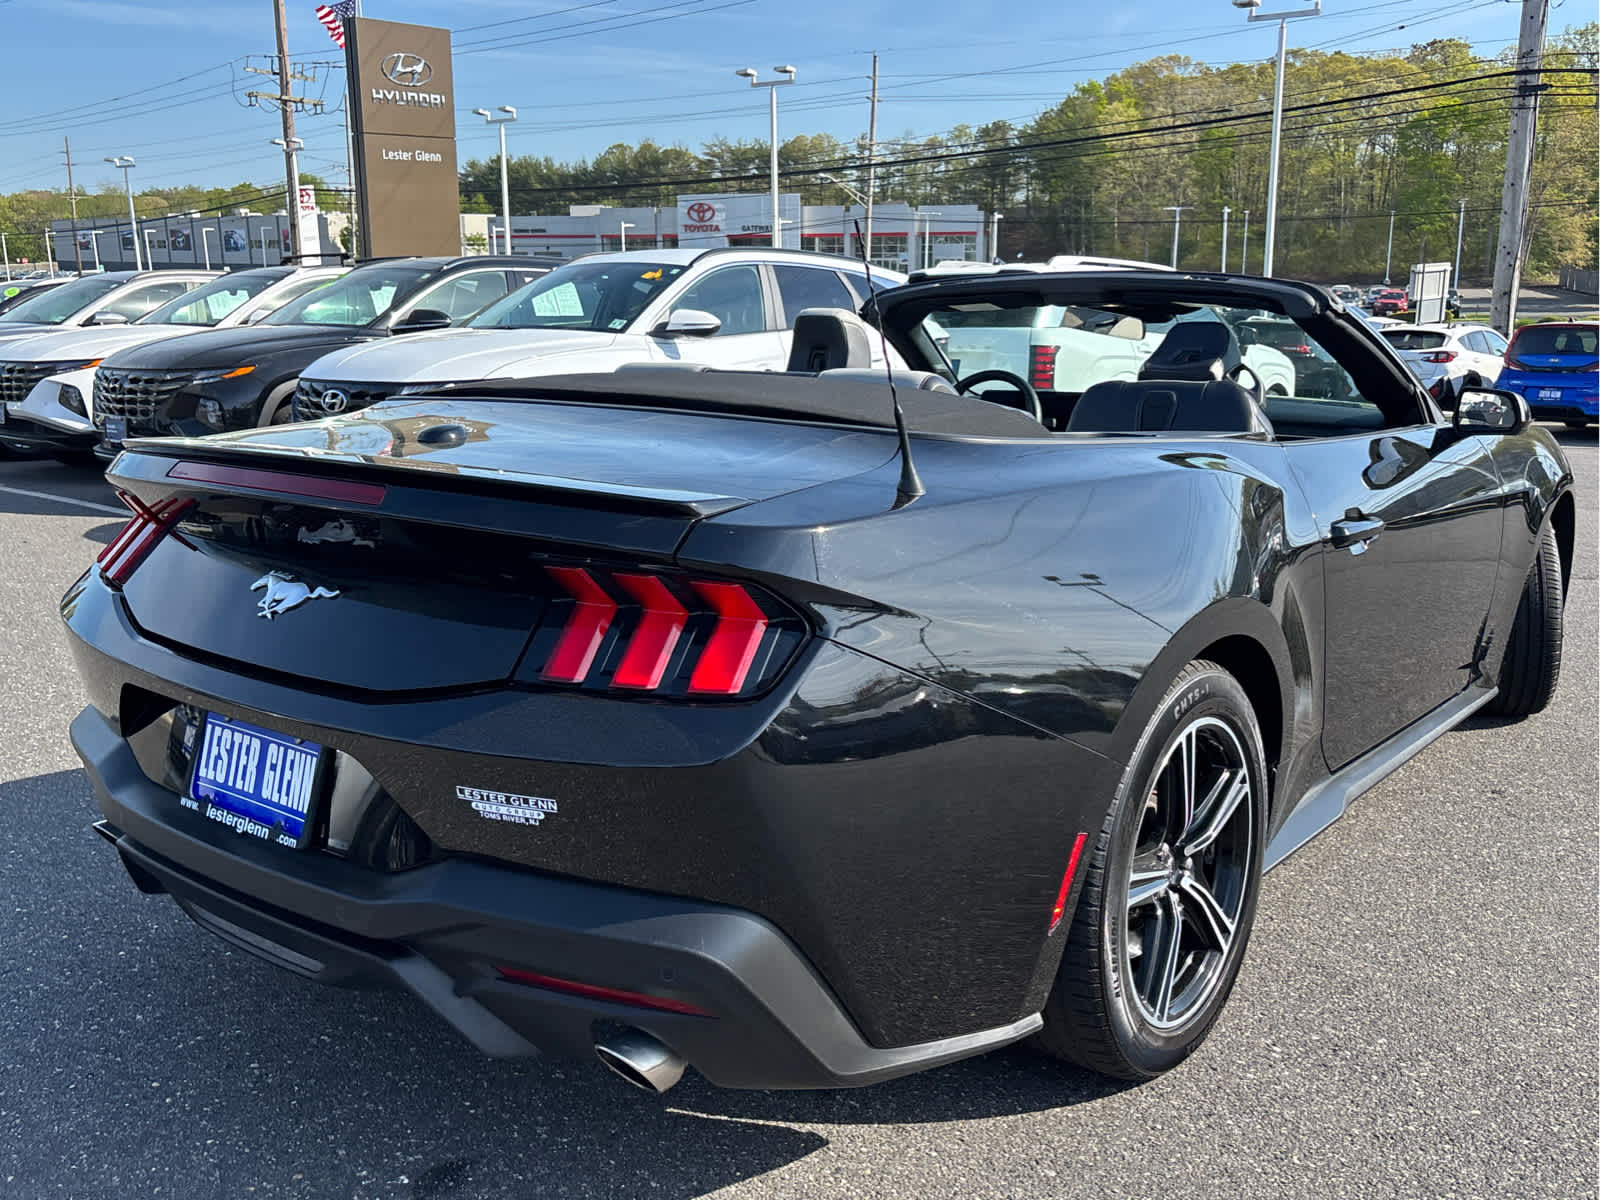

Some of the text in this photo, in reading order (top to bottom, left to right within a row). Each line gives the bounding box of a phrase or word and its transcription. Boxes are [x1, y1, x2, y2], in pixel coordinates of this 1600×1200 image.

[371, 88, 446, 107] HYUNDAI
[382, 148, 442, 162] Lester Glenn
[683, 224, 721, 232] TOYOTA
[199, 724, 317, 815] LESTER GLENN
[456, 786, 558, 811] LESTER GLENN
[180, 797, 297, 849] www. lesterglenn .com
[480, 810, 501, 820] TOMS
